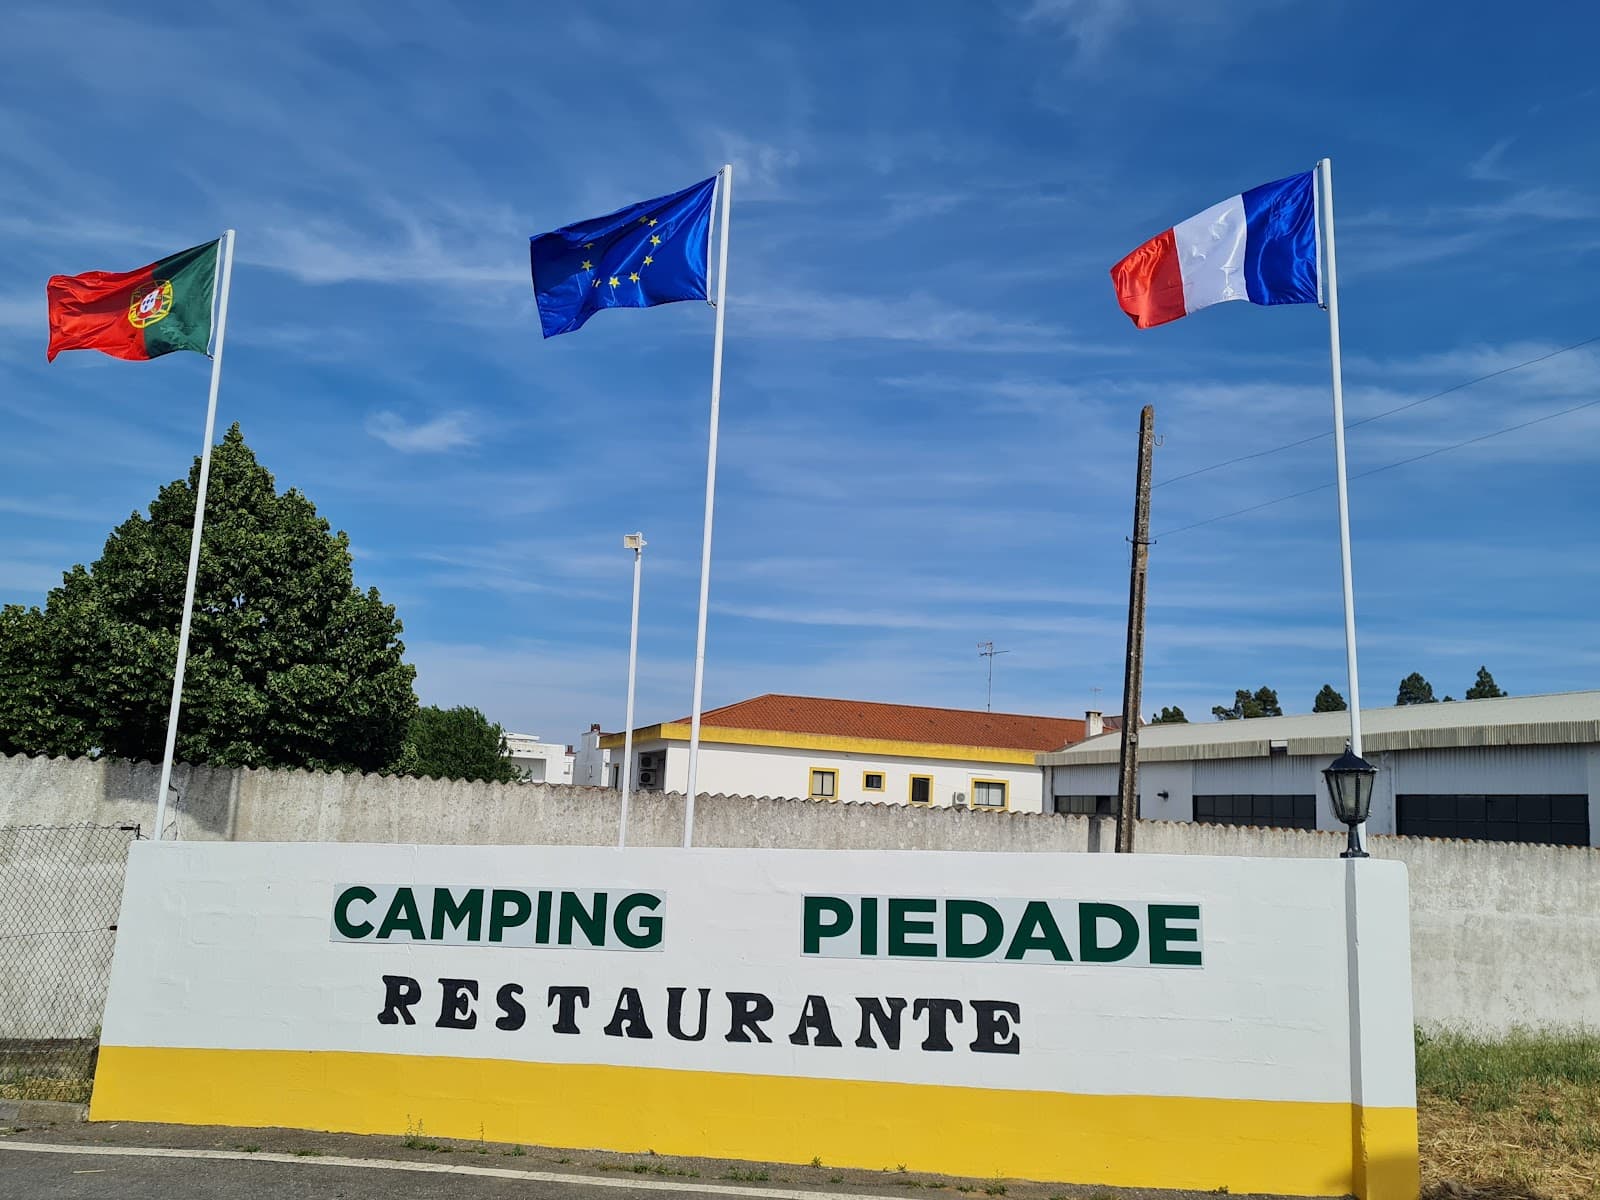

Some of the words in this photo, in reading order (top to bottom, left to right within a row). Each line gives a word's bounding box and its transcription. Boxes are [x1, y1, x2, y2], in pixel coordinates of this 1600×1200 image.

[333, 885, 664, 950] CAMPING
[803, 895, 1203, 966] PIEDADE
[377, 974, 1021, 1055] RESTAURANTE
